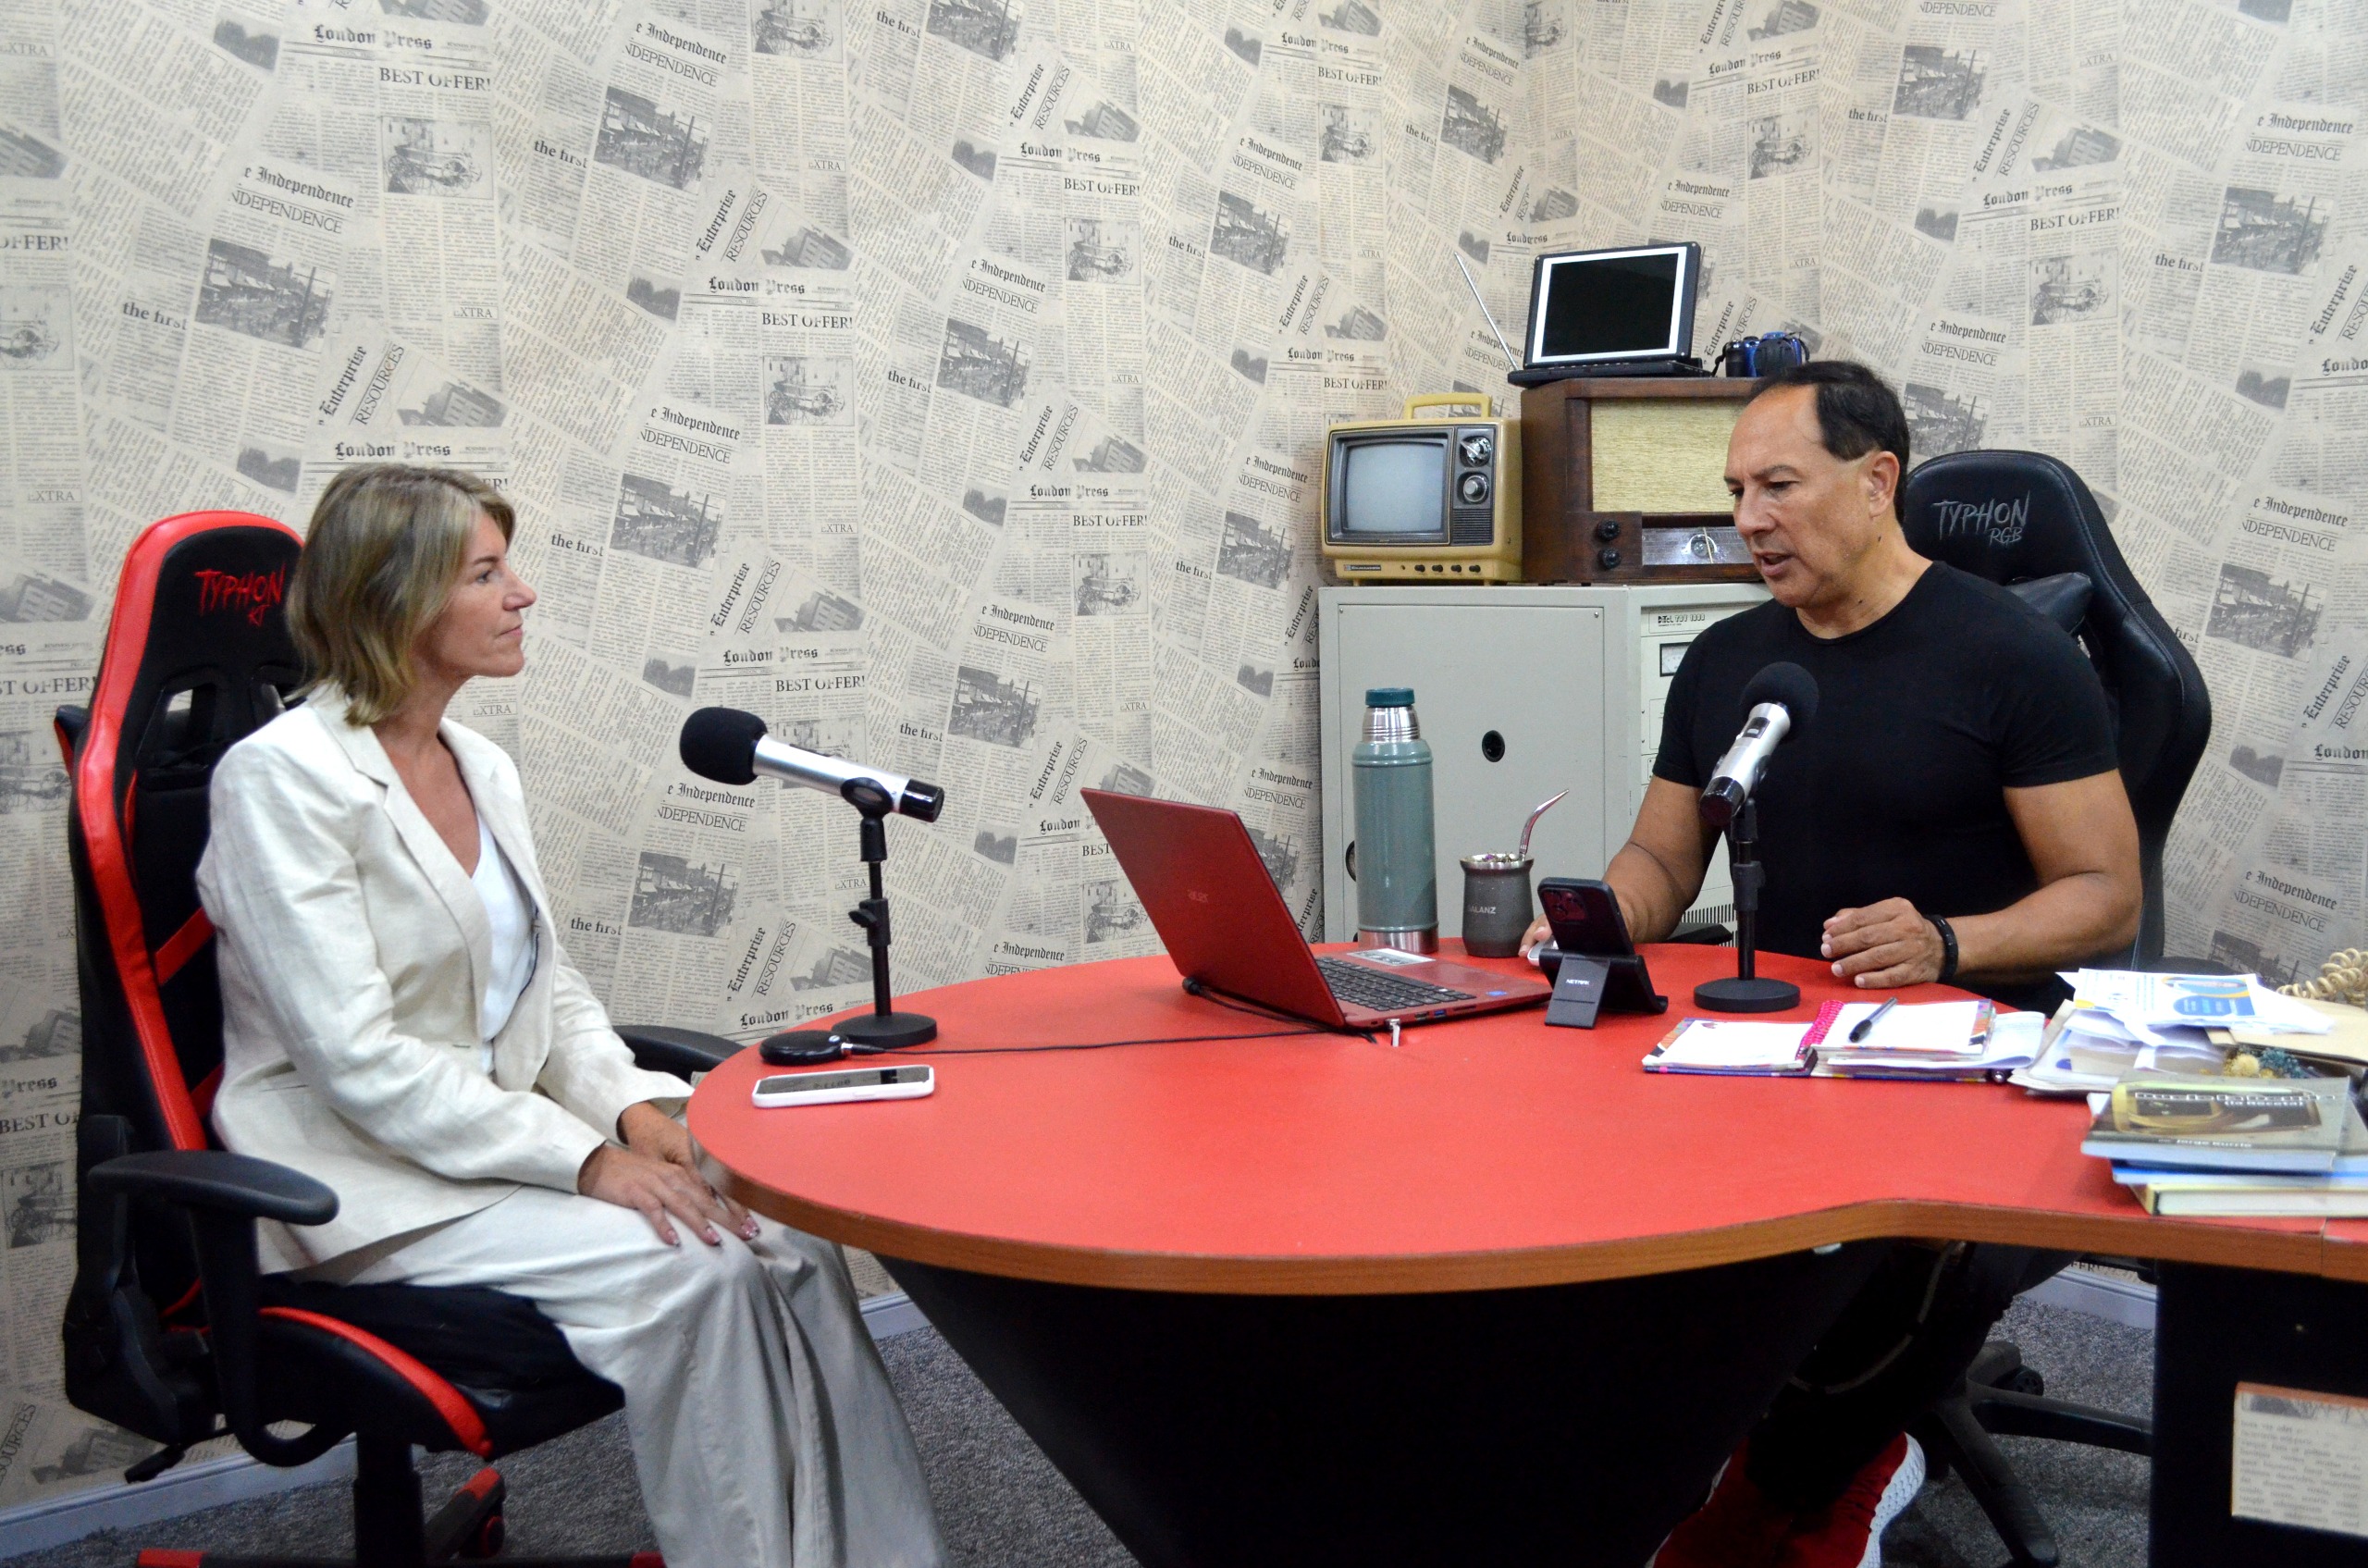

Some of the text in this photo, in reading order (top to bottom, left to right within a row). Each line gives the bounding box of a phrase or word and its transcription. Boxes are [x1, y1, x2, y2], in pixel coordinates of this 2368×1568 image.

[877, 10, 894, 27] the
[314, 24, 376, 43] London
[647, 21, 727, 65] Independence
[1282, 32, 1317, 49] London
[1472, 36, 1519, 70] Independence
[379, 68, 423, 84] BEST
[1318, 67, 1344, 81] BEST
[1708, 56, 1745, 78] London
[1010, 63, 1044, 119] Enterprise
[1746, 78, 1775, 94] BEST
[1036, 66, 1071, 130] RESOURCES
[1849, 108, 1864, 120] the
[2269, 114, 2353, 133] Independence
[1406, 123, 1419, 139] the
[1973, 107, 2010, 171] Enterprise
[1999, 104, 2040, 176] RESOURCES
[534, 140, 556, 157] the
[1020, 142, 1063, 161] London
[1249, 136, 1303, 170] Independence
[257, 167, 353, 208] Independence
[1064, 178, 1094, 191] BEST
[1499, 166, 1524, 213] Enterprise
[1674, 179, 1730, 199] Independence
[1983, 189, 2029, 208] London
[697, 189, 736, 253] Enterprise
[725, 191, 769, 262] RESOURCES
[2030, 214, 2064, 230] BEST
[1167, 236, 1185, 251] the
[2155, 253, 2176, 266] the
[709, 276, 758, 293] London
[980, 259, 1046, 294] Independence
[1280, 275, 1309, 328] Enterprise
[1301, 275, 1330, 336] RESOURCES
[2312, 264, 2357, 334] Enterprise
[123, 302, 149, 319] the
[762, 313, 797, 326] BEST
[1705, 301, 1734, 356] Enterprise
[1938, 319, 2006, 343] Independence
[1288, 348, 1323, 364] London
[319, 346, 366, 416] Enterprise
[355, 344, 404, 426] RESOURCES
[888, 370, 906, 387] the
[1324, 377, 1349, 389] BEST
[660, 406, 740, 440] Independence
[1020, 404, 1053, 463] Enterprise
[1044, 404, 1079, 471] RESOURCES
[335, 441, 396, 461] London
[1254, 455, 1308, 485] Independence
[1030, 483, 1072, 500] London
[1074, 514, 1102, 527] BEST
[1931, 490, 2030, 540] TYPHON
[2264, 497, 2348, 527] Independence
[551, 534, 573, 551] the
[1989, 526, 2023, 548] RGB
[1176, 561, 1191, 574] the
[195, 562, 286, 617] TYPHON
[710, 562, 749, 627] Enterprise
[740, 561, 781, 635] RESOURCES
[990, 603, 1054, 632] Independence
[1285, 585, 1314, 639] Enterprise
[723, 648, 773, 664] London
[776, 677, 810, 693] BEST
[2304, 655, 2350, 721] Enterprise
[900, 722, 918, 737] the
[1030, 740, 1062, 800] Enterprise
[1054, 737, 1088, 806] RESOURCES
[1258, 768, 1313, 790] Independence
[679, 783, 755, 809] Independence
[1040, 816, 1081, 832] London
[1082, 843, 1110, 856] BEST
[2257, 870, 2337, 910] Independence
[571, 917, 591, 932] the
[728, 926, 766, 993] Enterprise
[757, 921, 796, 996] RESOURCES
[1002, 941, 1065, 961] Independence
[741, 1009, 789, 1030] London
